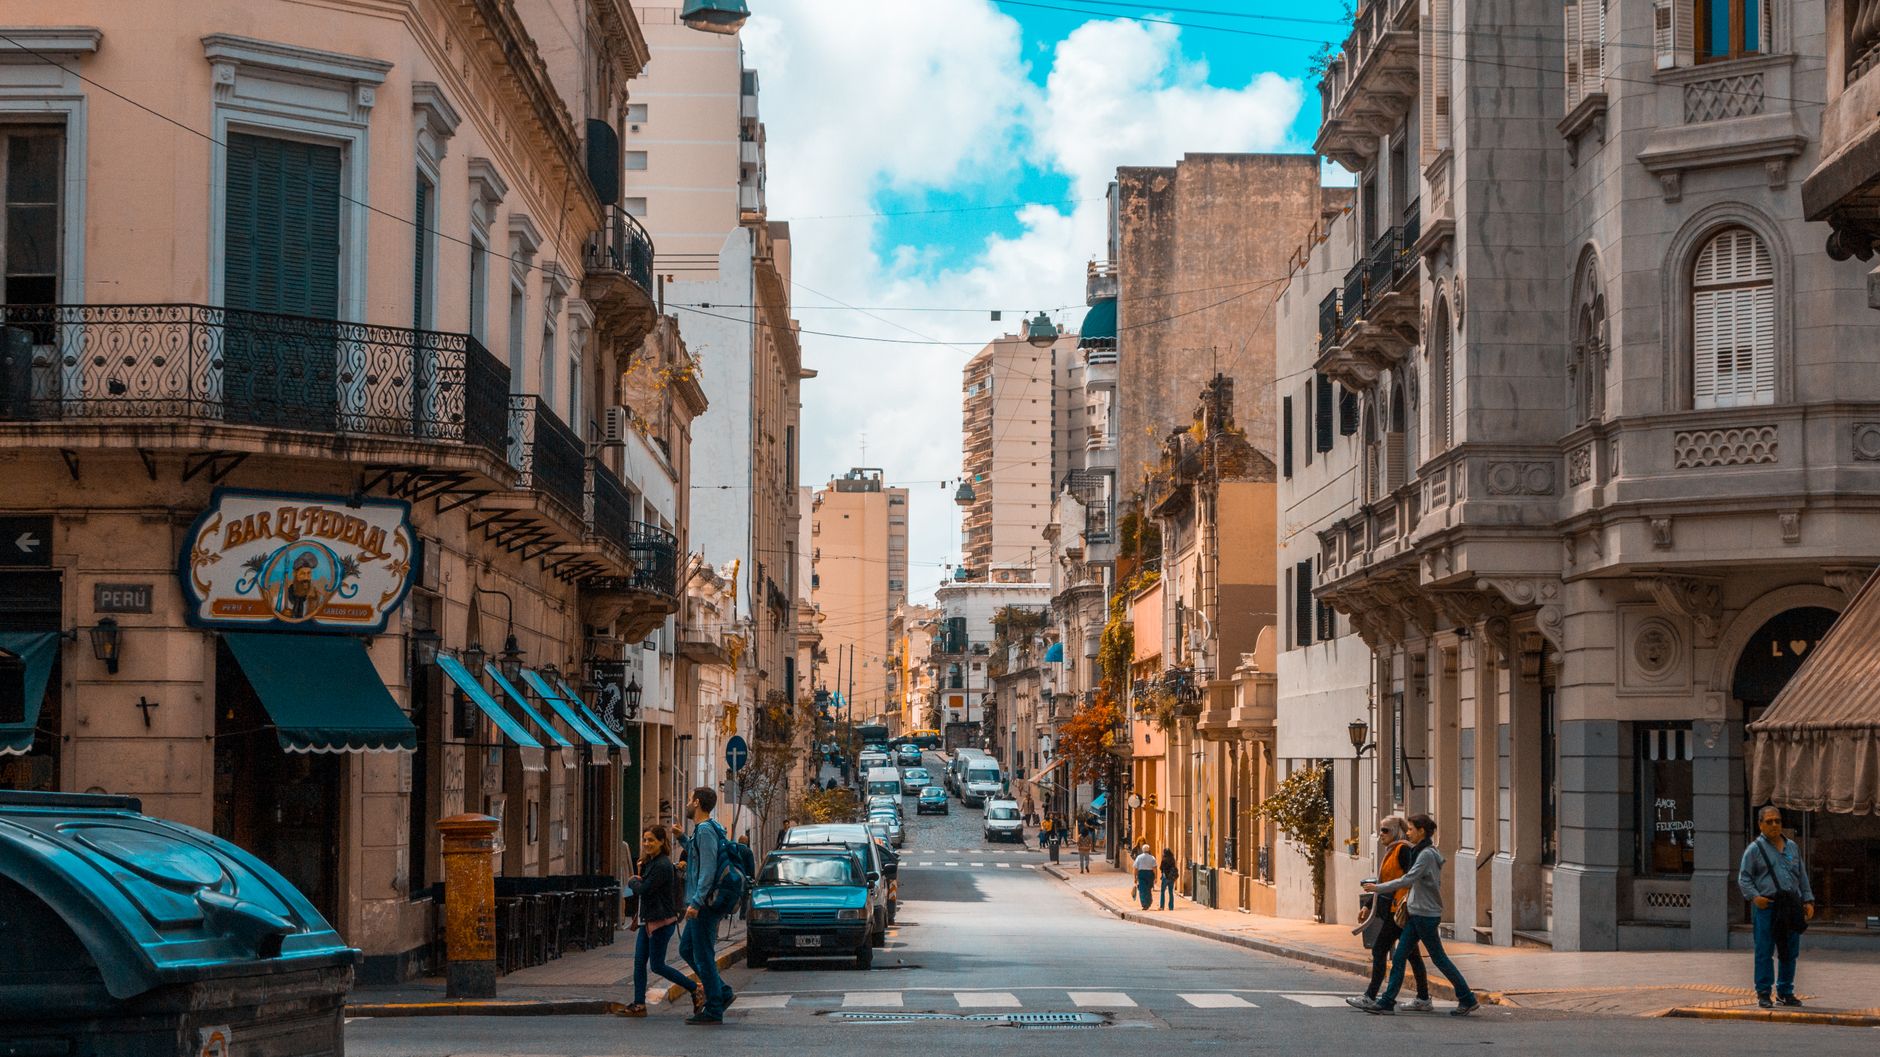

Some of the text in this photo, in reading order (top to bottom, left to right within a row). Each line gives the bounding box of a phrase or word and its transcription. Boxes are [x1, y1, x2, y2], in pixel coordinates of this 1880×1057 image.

[220, 506, 391, 562] BAR EL FEDERAL
[101, 587, 145, 607] PERÚ
[1655, 798, 1676, 809] AMOR
[1656, 820, 1694, 831] FELICIDAD
